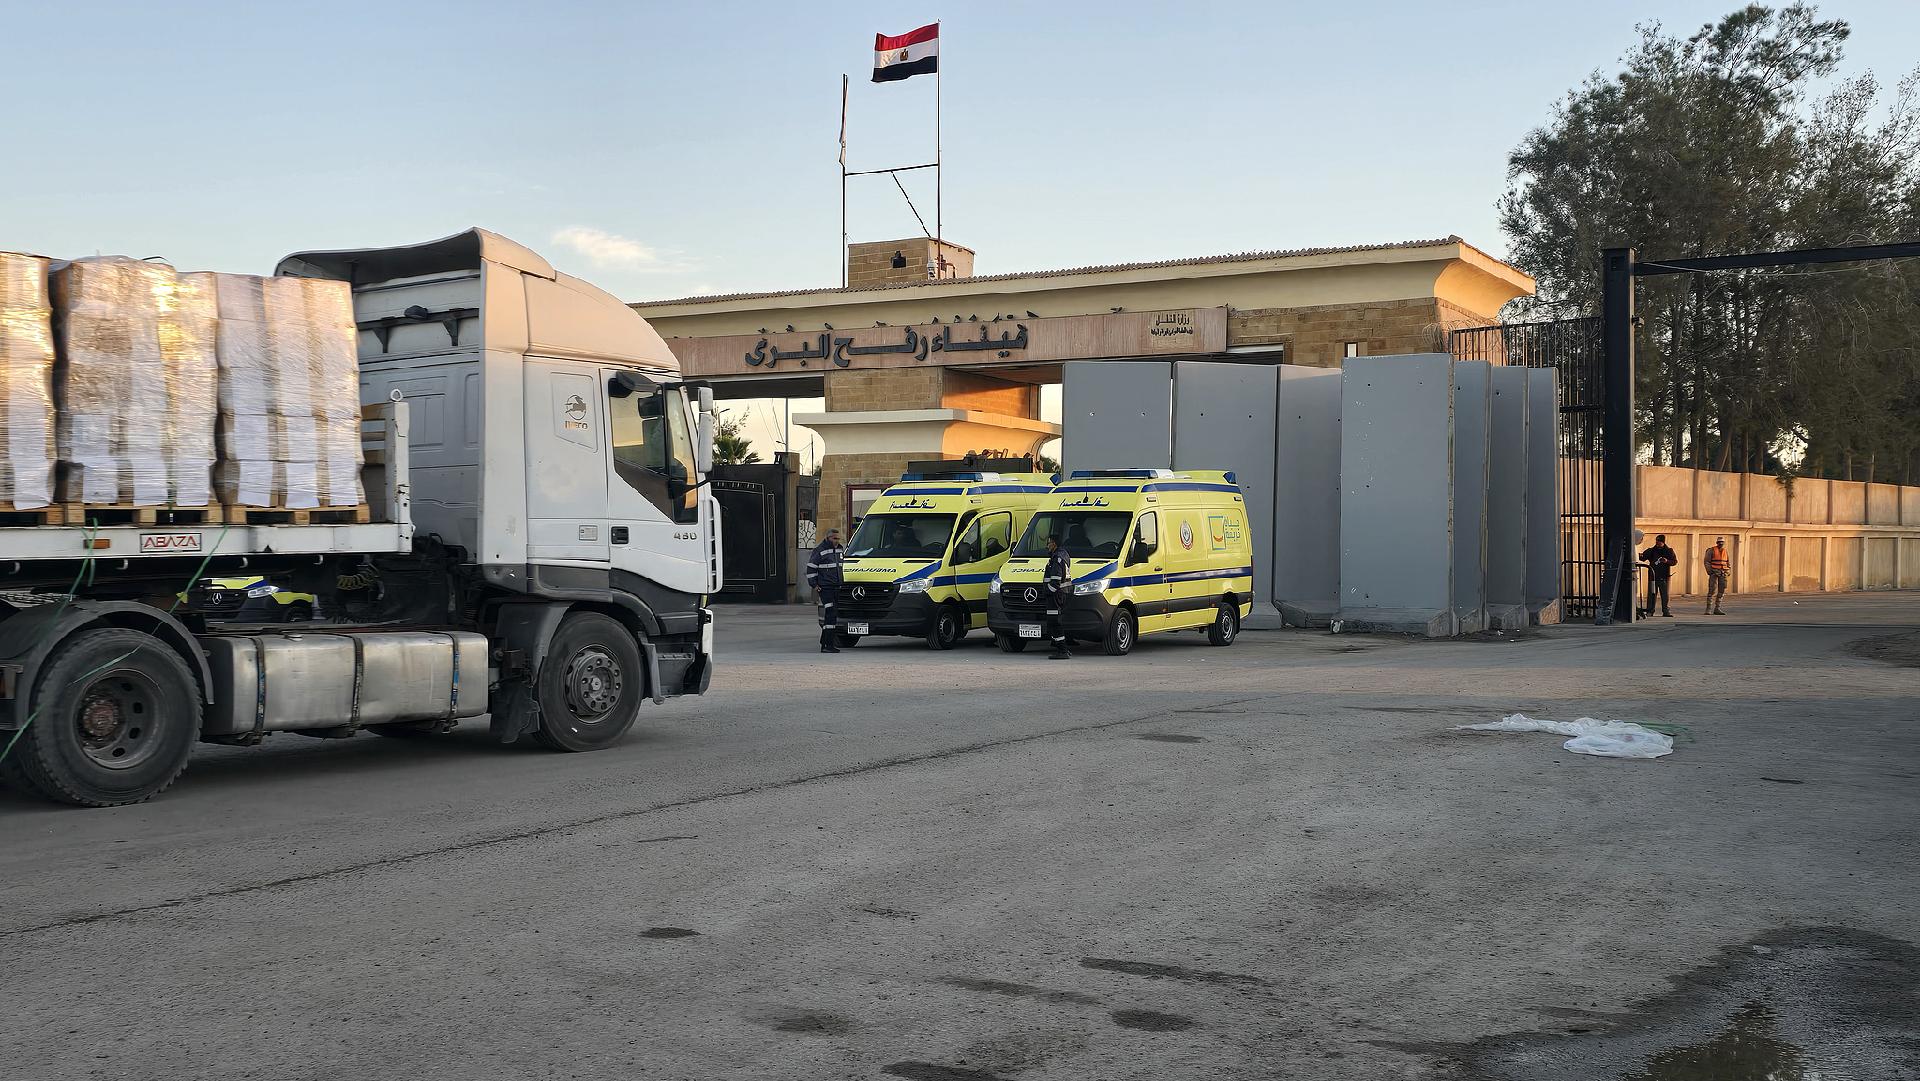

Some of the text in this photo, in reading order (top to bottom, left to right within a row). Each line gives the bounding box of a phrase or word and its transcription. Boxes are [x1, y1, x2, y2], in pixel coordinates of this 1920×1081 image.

[833, 325, 928, 368] رفح
[931, 323, 1028, 358] ميناء
[144, 536, 198, 547] ABAZA
